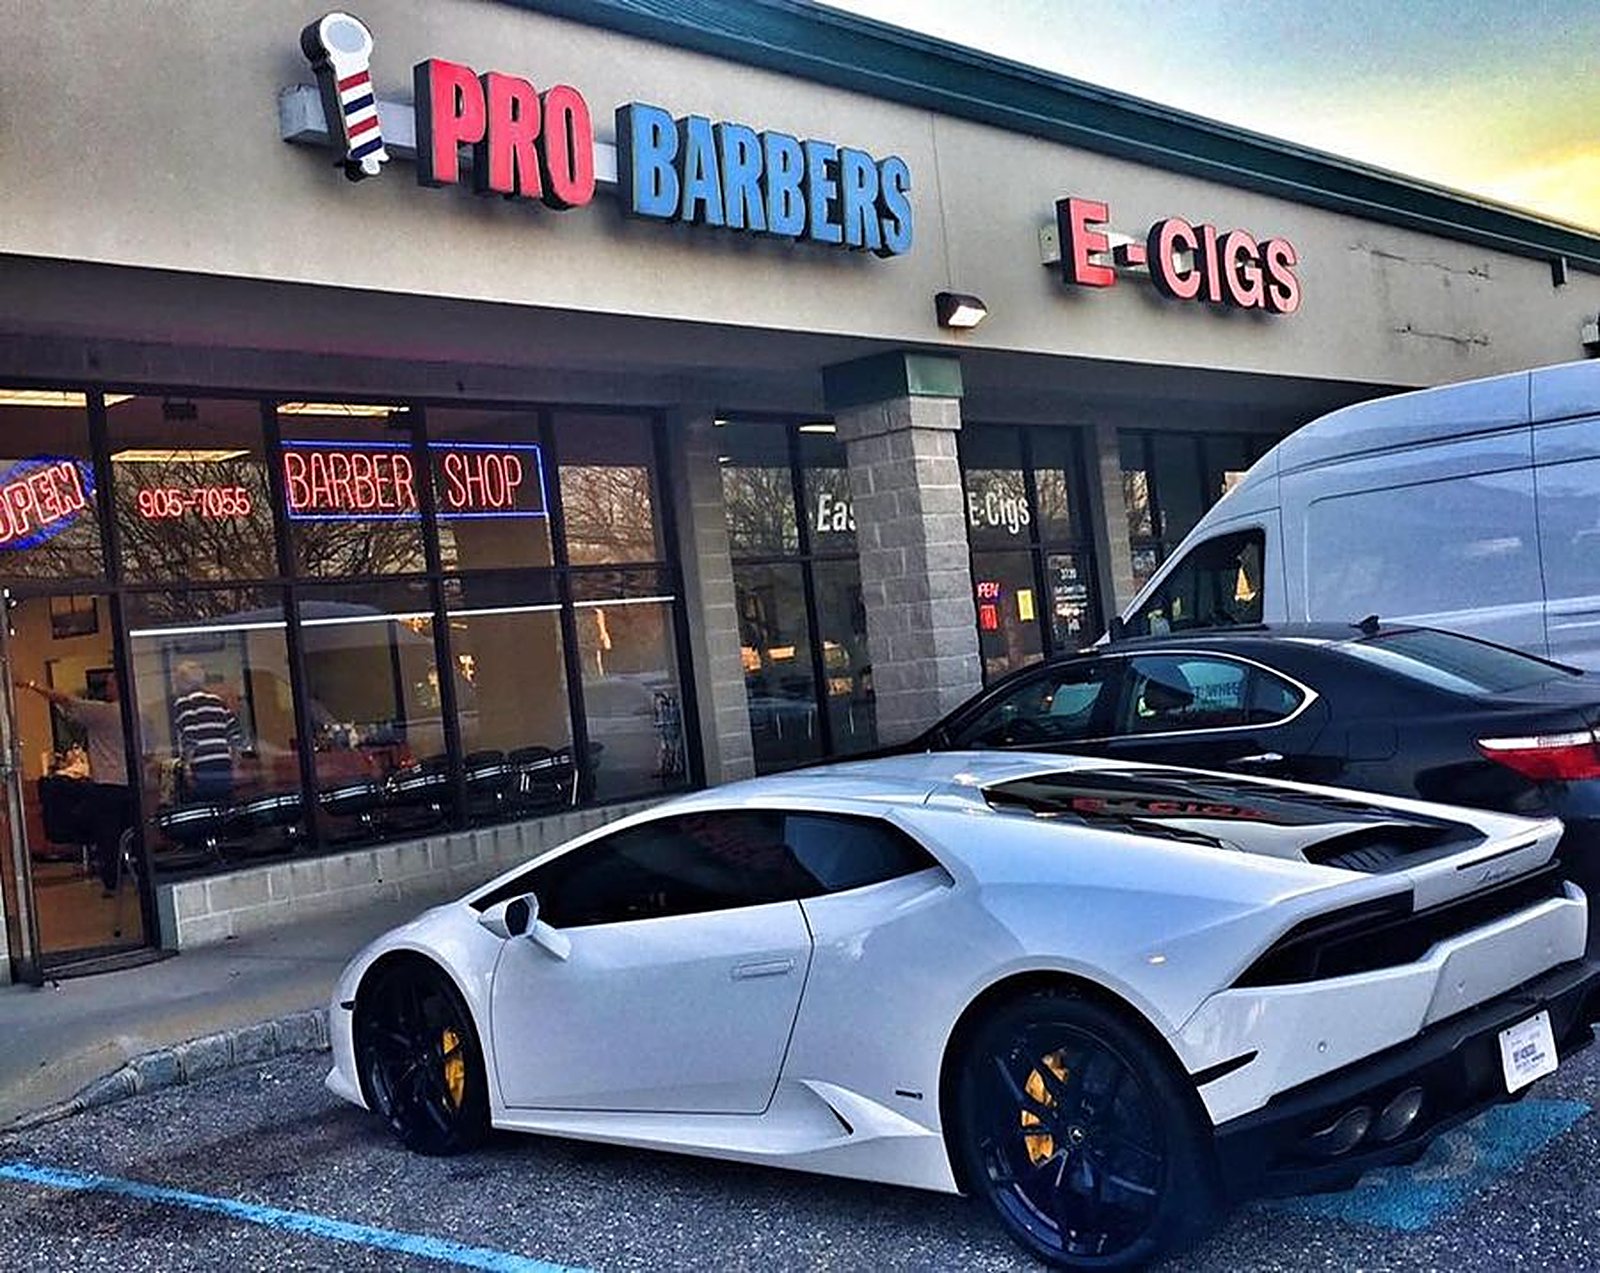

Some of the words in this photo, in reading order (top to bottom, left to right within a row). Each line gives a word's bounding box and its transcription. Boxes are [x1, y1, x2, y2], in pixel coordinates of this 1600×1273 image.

[414, 57, 595, 209] PRO
[616, 102, 912, 257] BARBERS
[1056, 197, 1300, 315] E-CIGS
[139, 487, 250, 517] 905-7055
[284, 452, 416, 508] BARBER
[444, 453, 522, 507] SHOP
